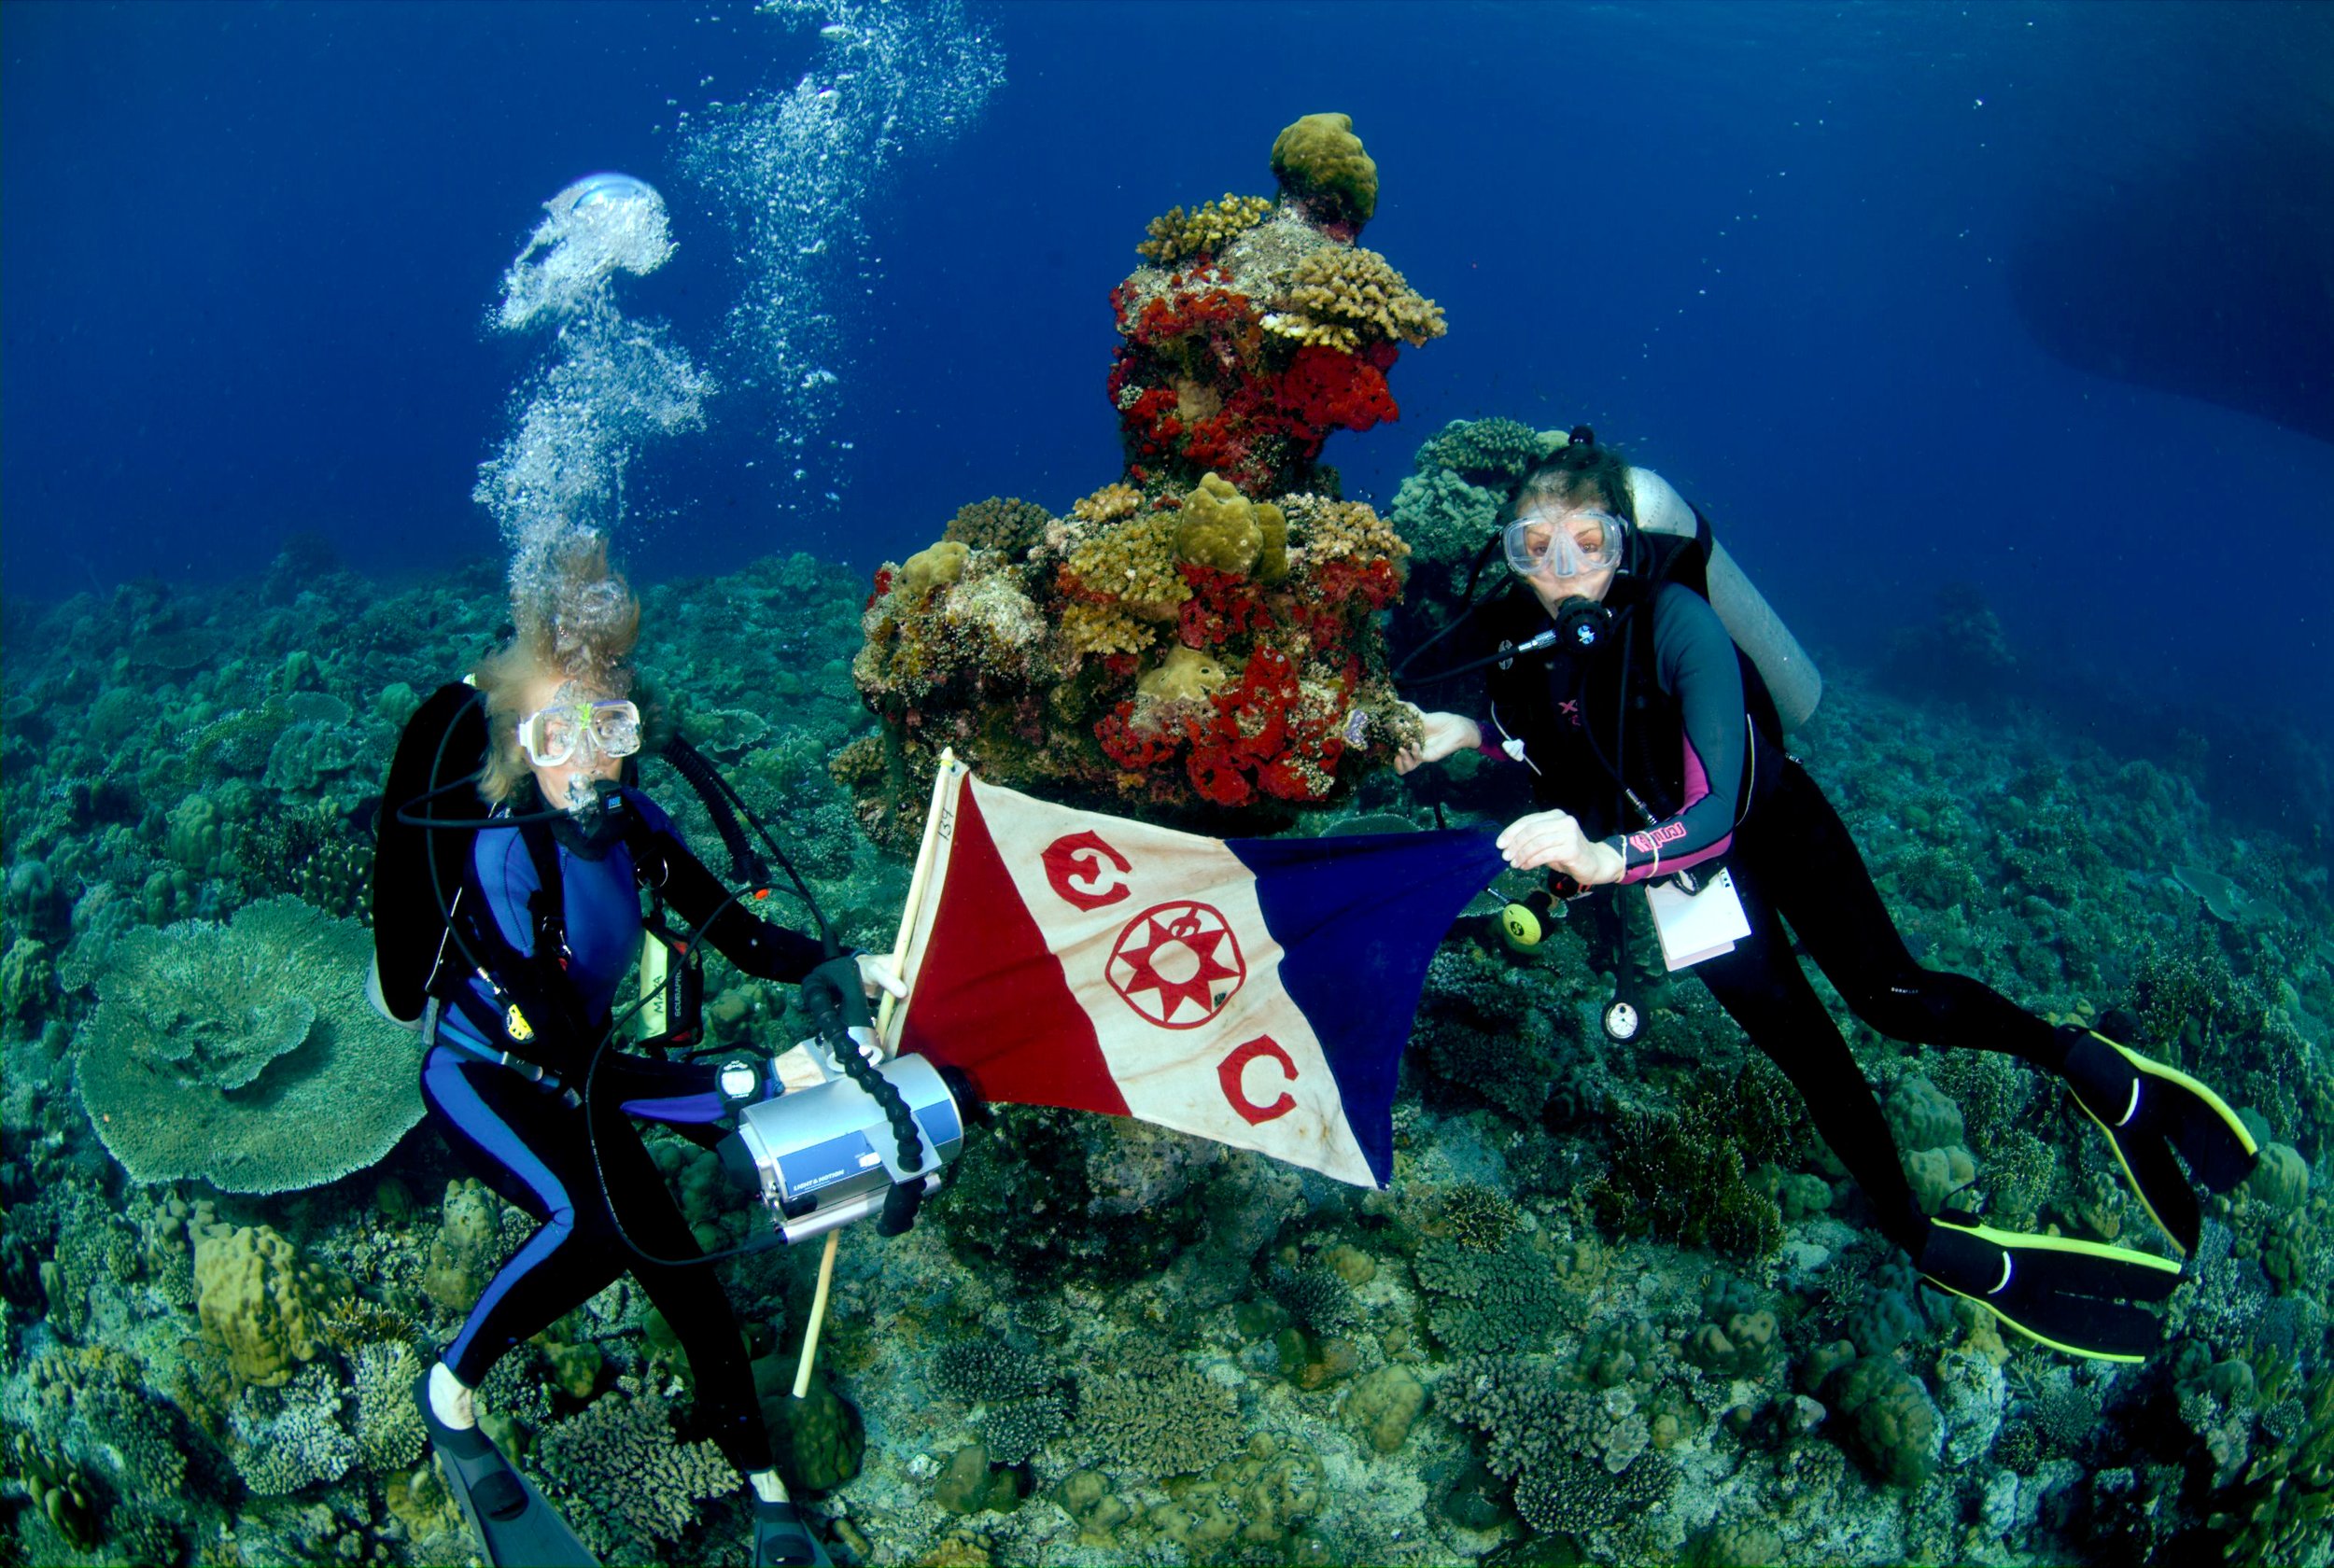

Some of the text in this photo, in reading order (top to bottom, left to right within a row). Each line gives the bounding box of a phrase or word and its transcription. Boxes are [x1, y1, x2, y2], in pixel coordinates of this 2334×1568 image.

[1041, 829, 1132, 913] E
[653, 974, 664, 1014] MAA
[1216, 1034, 1300, 1126] C
[794, 1181, 814, 1191] LIGHT
[818, 1169, 844, 1182] MOTION
